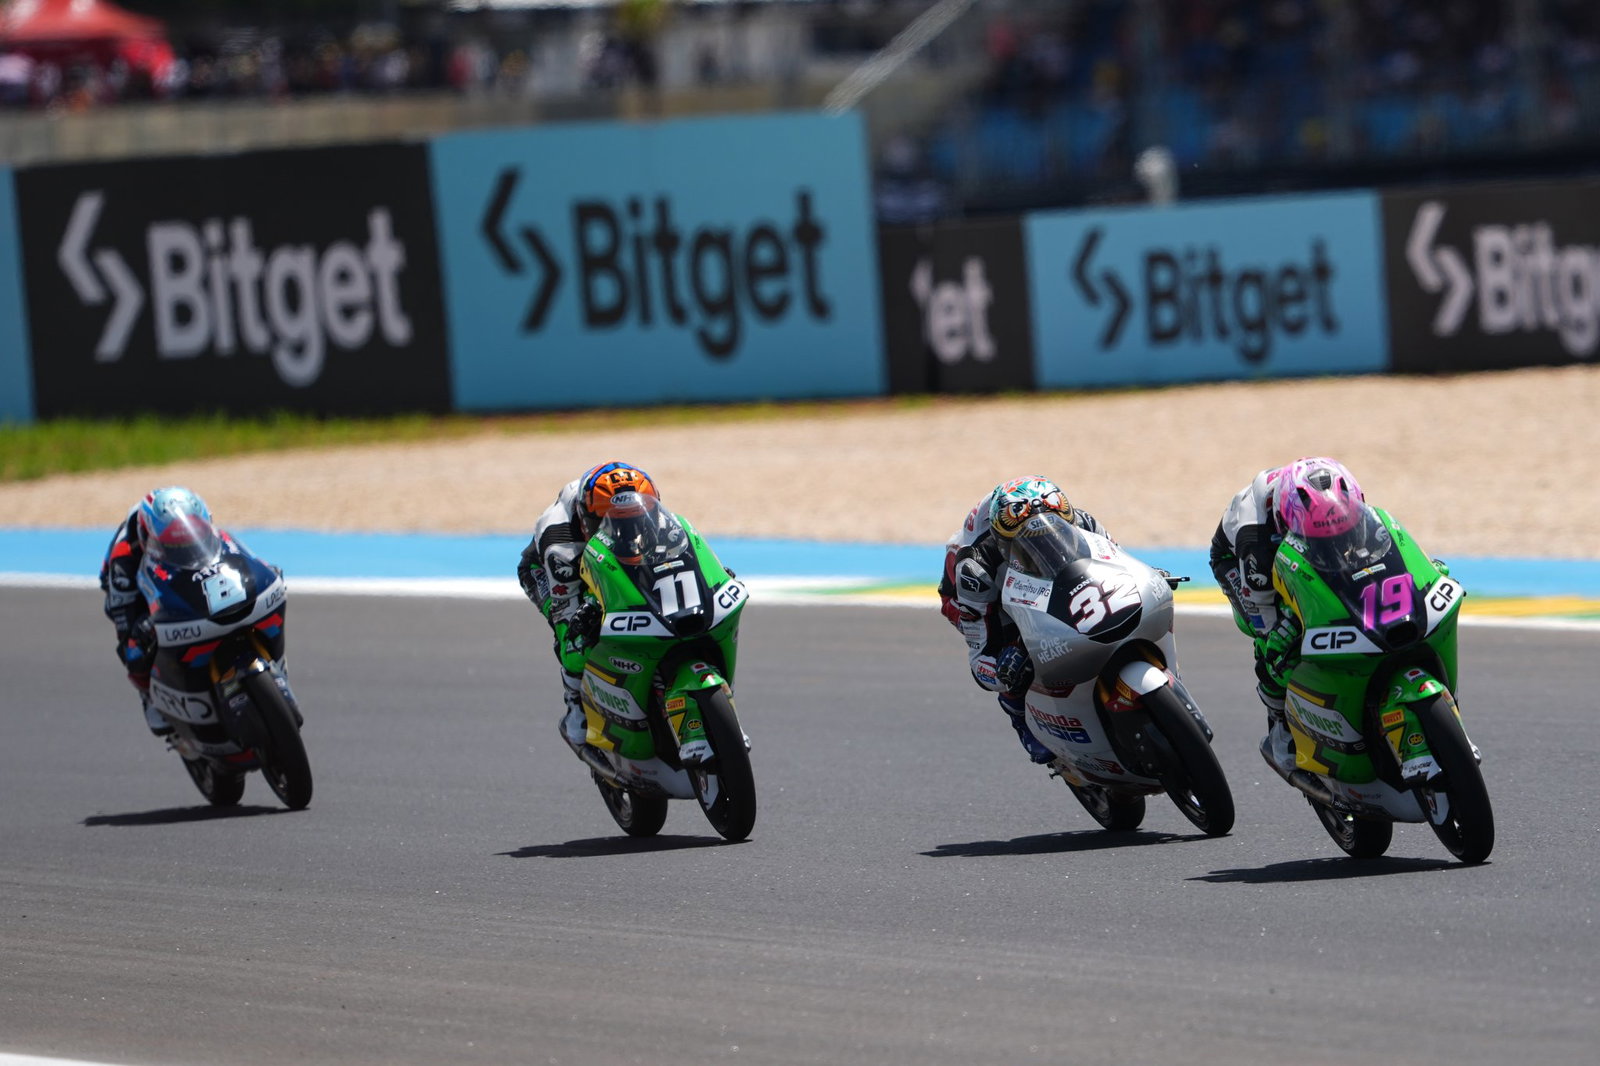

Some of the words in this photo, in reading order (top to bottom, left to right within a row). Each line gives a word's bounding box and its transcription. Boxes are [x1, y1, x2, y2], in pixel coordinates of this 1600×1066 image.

[147, 207, 412, 387] Bitget
[572, 187, 834, 362] Bitget
[1473, 221, 1600, 356] Bitg
[1142, 235, 1340, 363] Bitget
[652, 570, 701, 617] 11
[718, 584, 741, 609] CIP
[1069, 577, 1096, 596] HON
[1070, 579, 1142, 634] 32
[1360, 572, 1413, 632] 19
[1430, 583, 1454, 612] CIP
[610, 615, 652, 632] CIP
[1310, 631, 1357, 651] CIP
[1026, 702, 1083, 727] Honda
